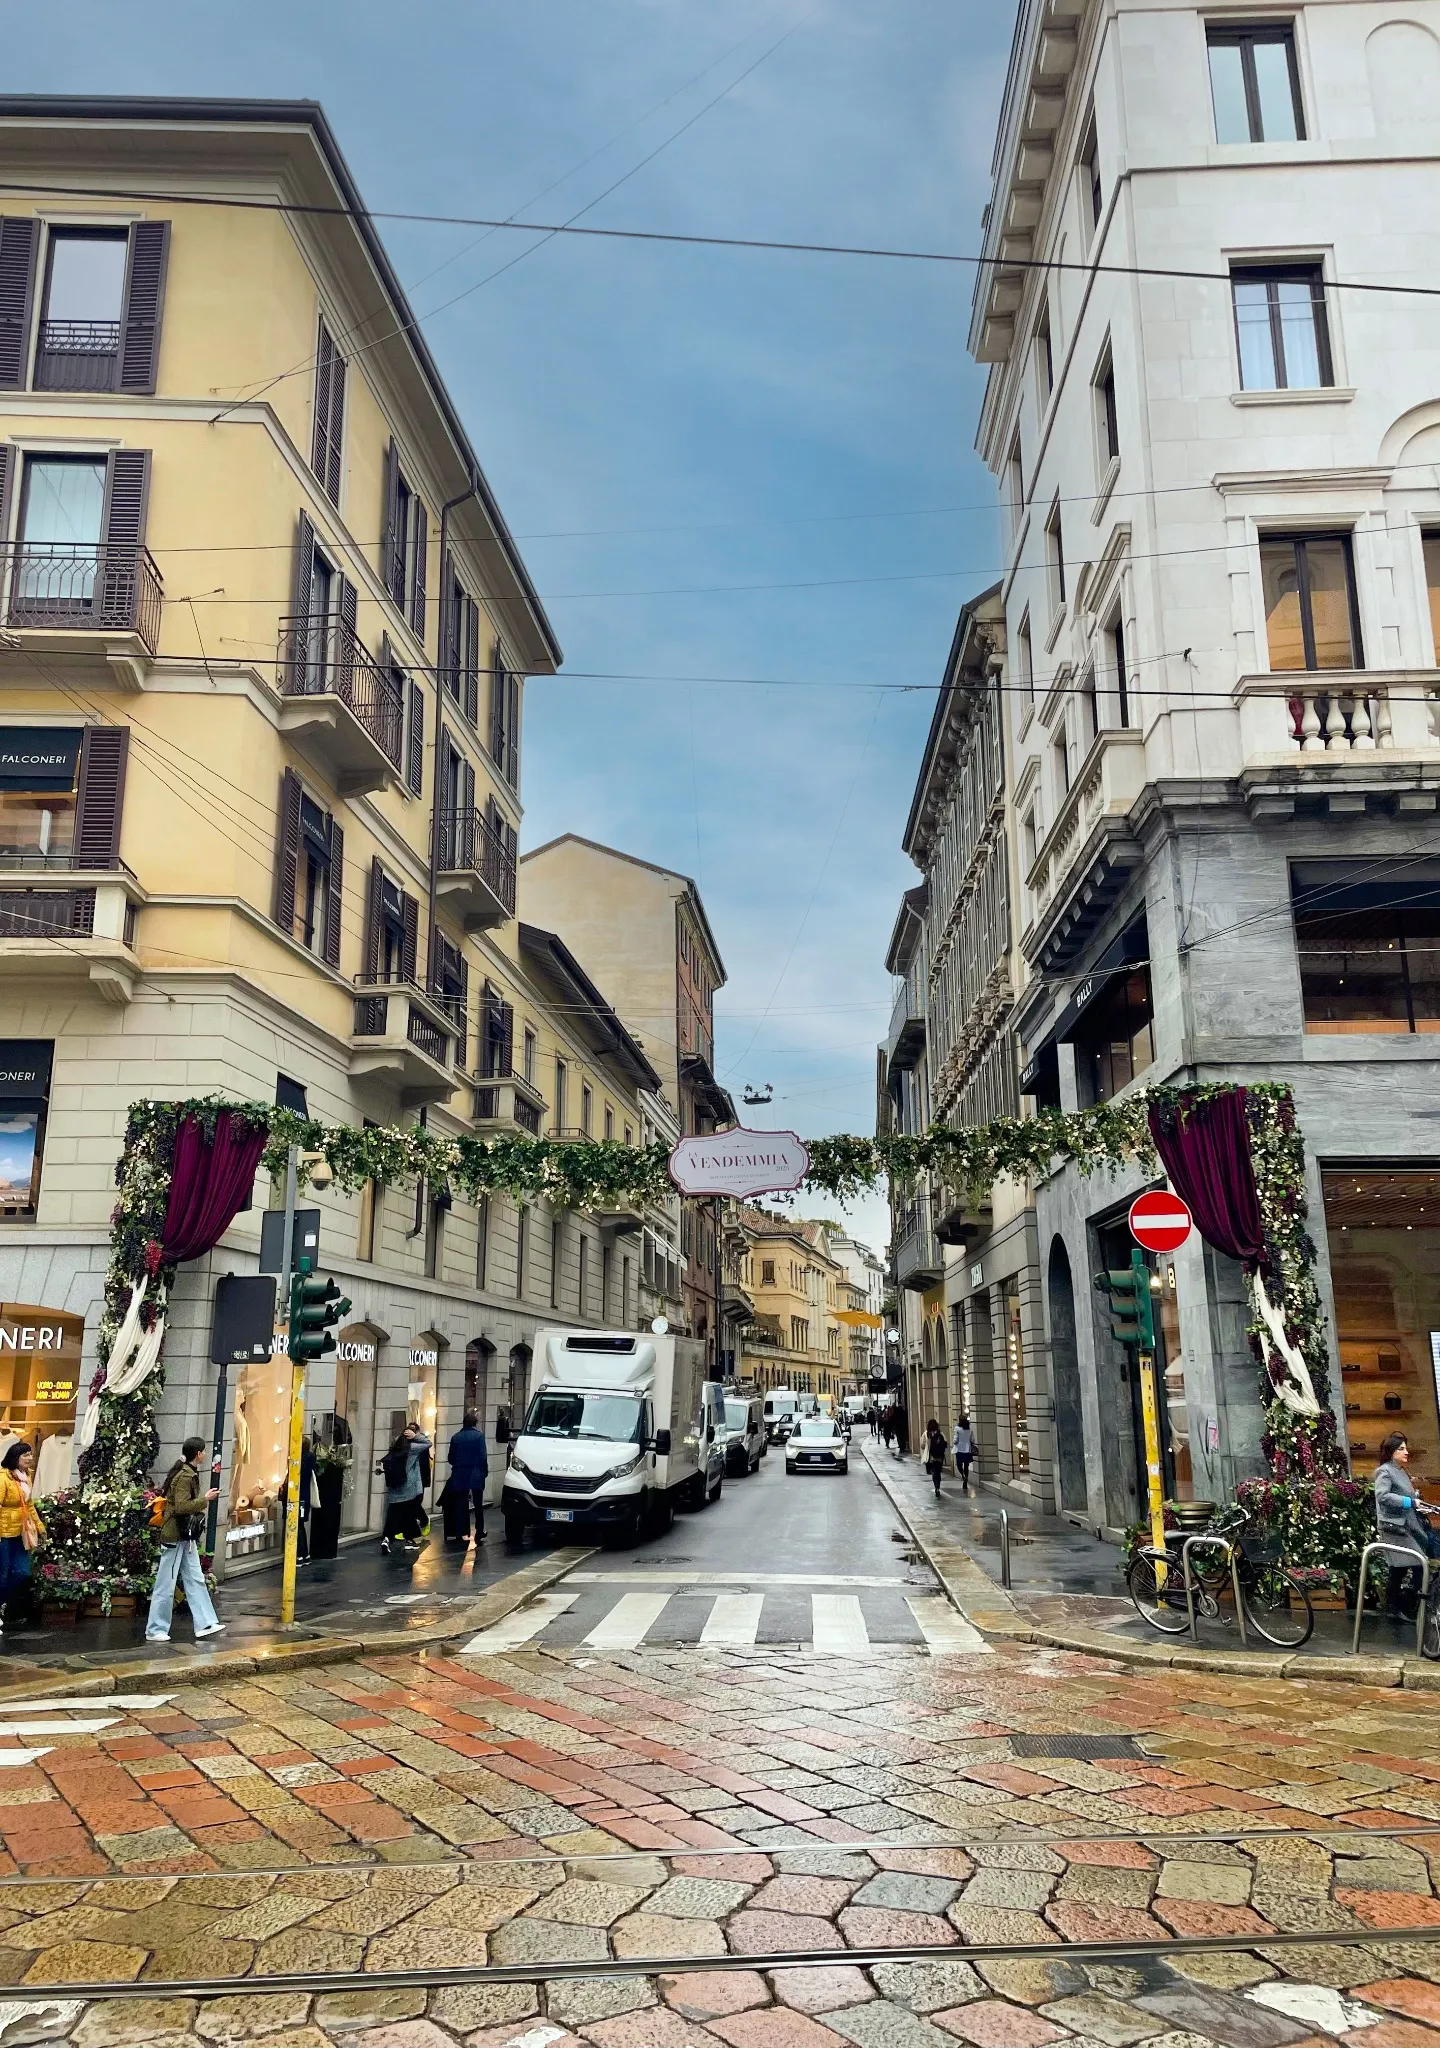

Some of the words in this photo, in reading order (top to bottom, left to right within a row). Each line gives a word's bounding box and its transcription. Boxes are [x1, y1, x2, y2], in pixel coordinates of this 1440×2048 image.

[2, 754, 67, 764] FALCONERI
[1076, 979, 1093, 1008] BALLY
[690, 1153, 789, 1169] VENDEMMIA
[0, 1327, 63, 1350] NERI
[549, 1462, 585, 1472] IVECO
